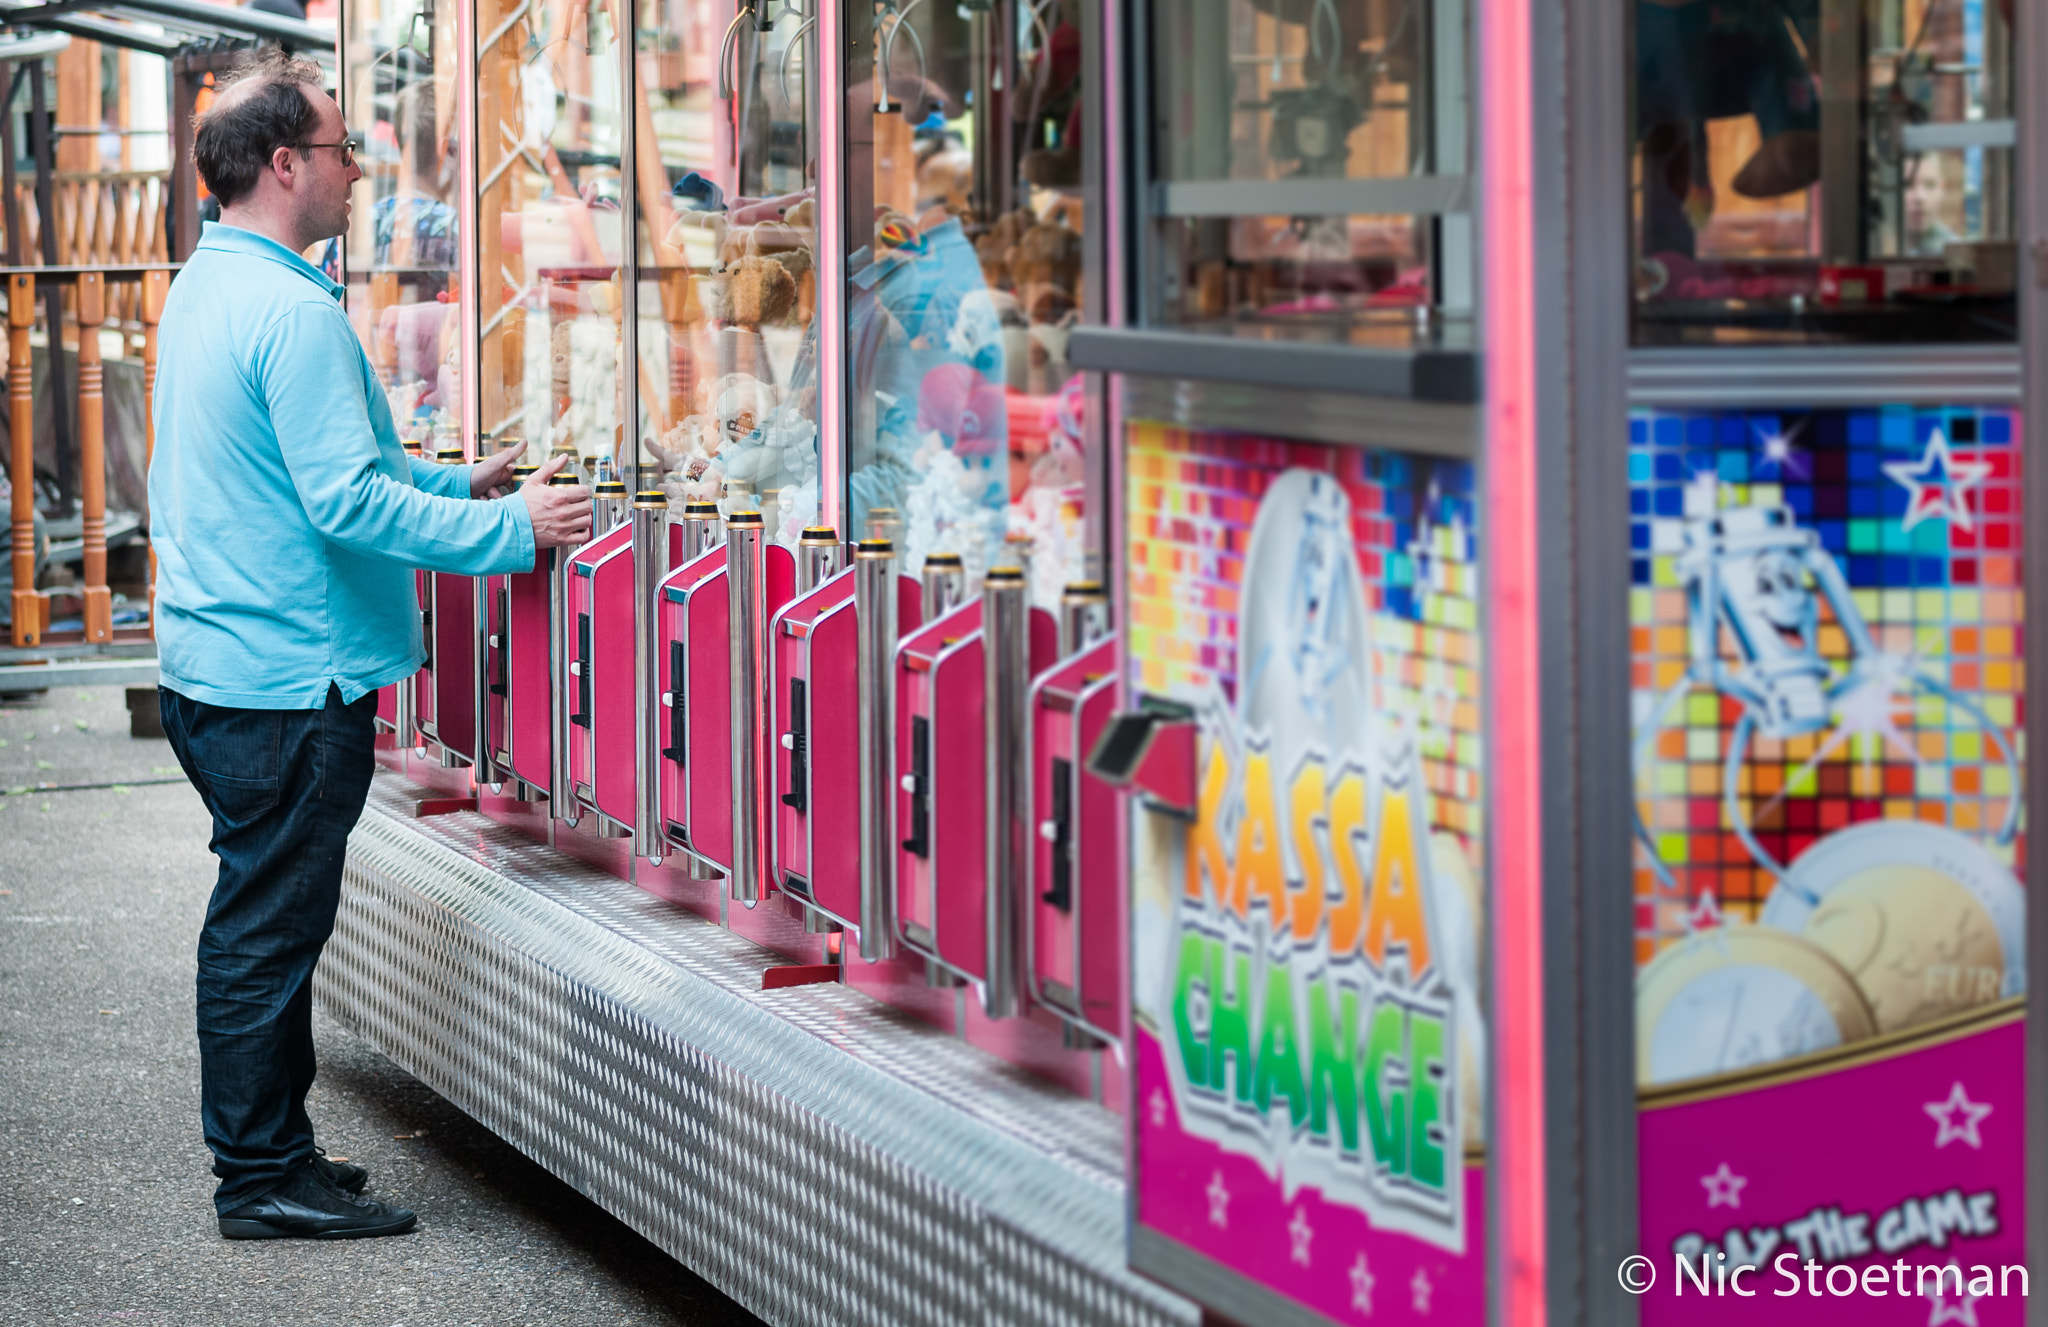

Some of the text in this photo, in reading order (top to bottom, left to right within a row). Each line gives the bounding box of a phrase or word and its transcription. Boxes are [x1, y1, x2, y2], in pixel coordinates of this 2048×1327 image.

[1184, 738, 1433, 979] KASSA
[1173, 931, 1446, 1189] CHANGE
[1672, 1188, 1998, 1283] PLAY THE GAME
